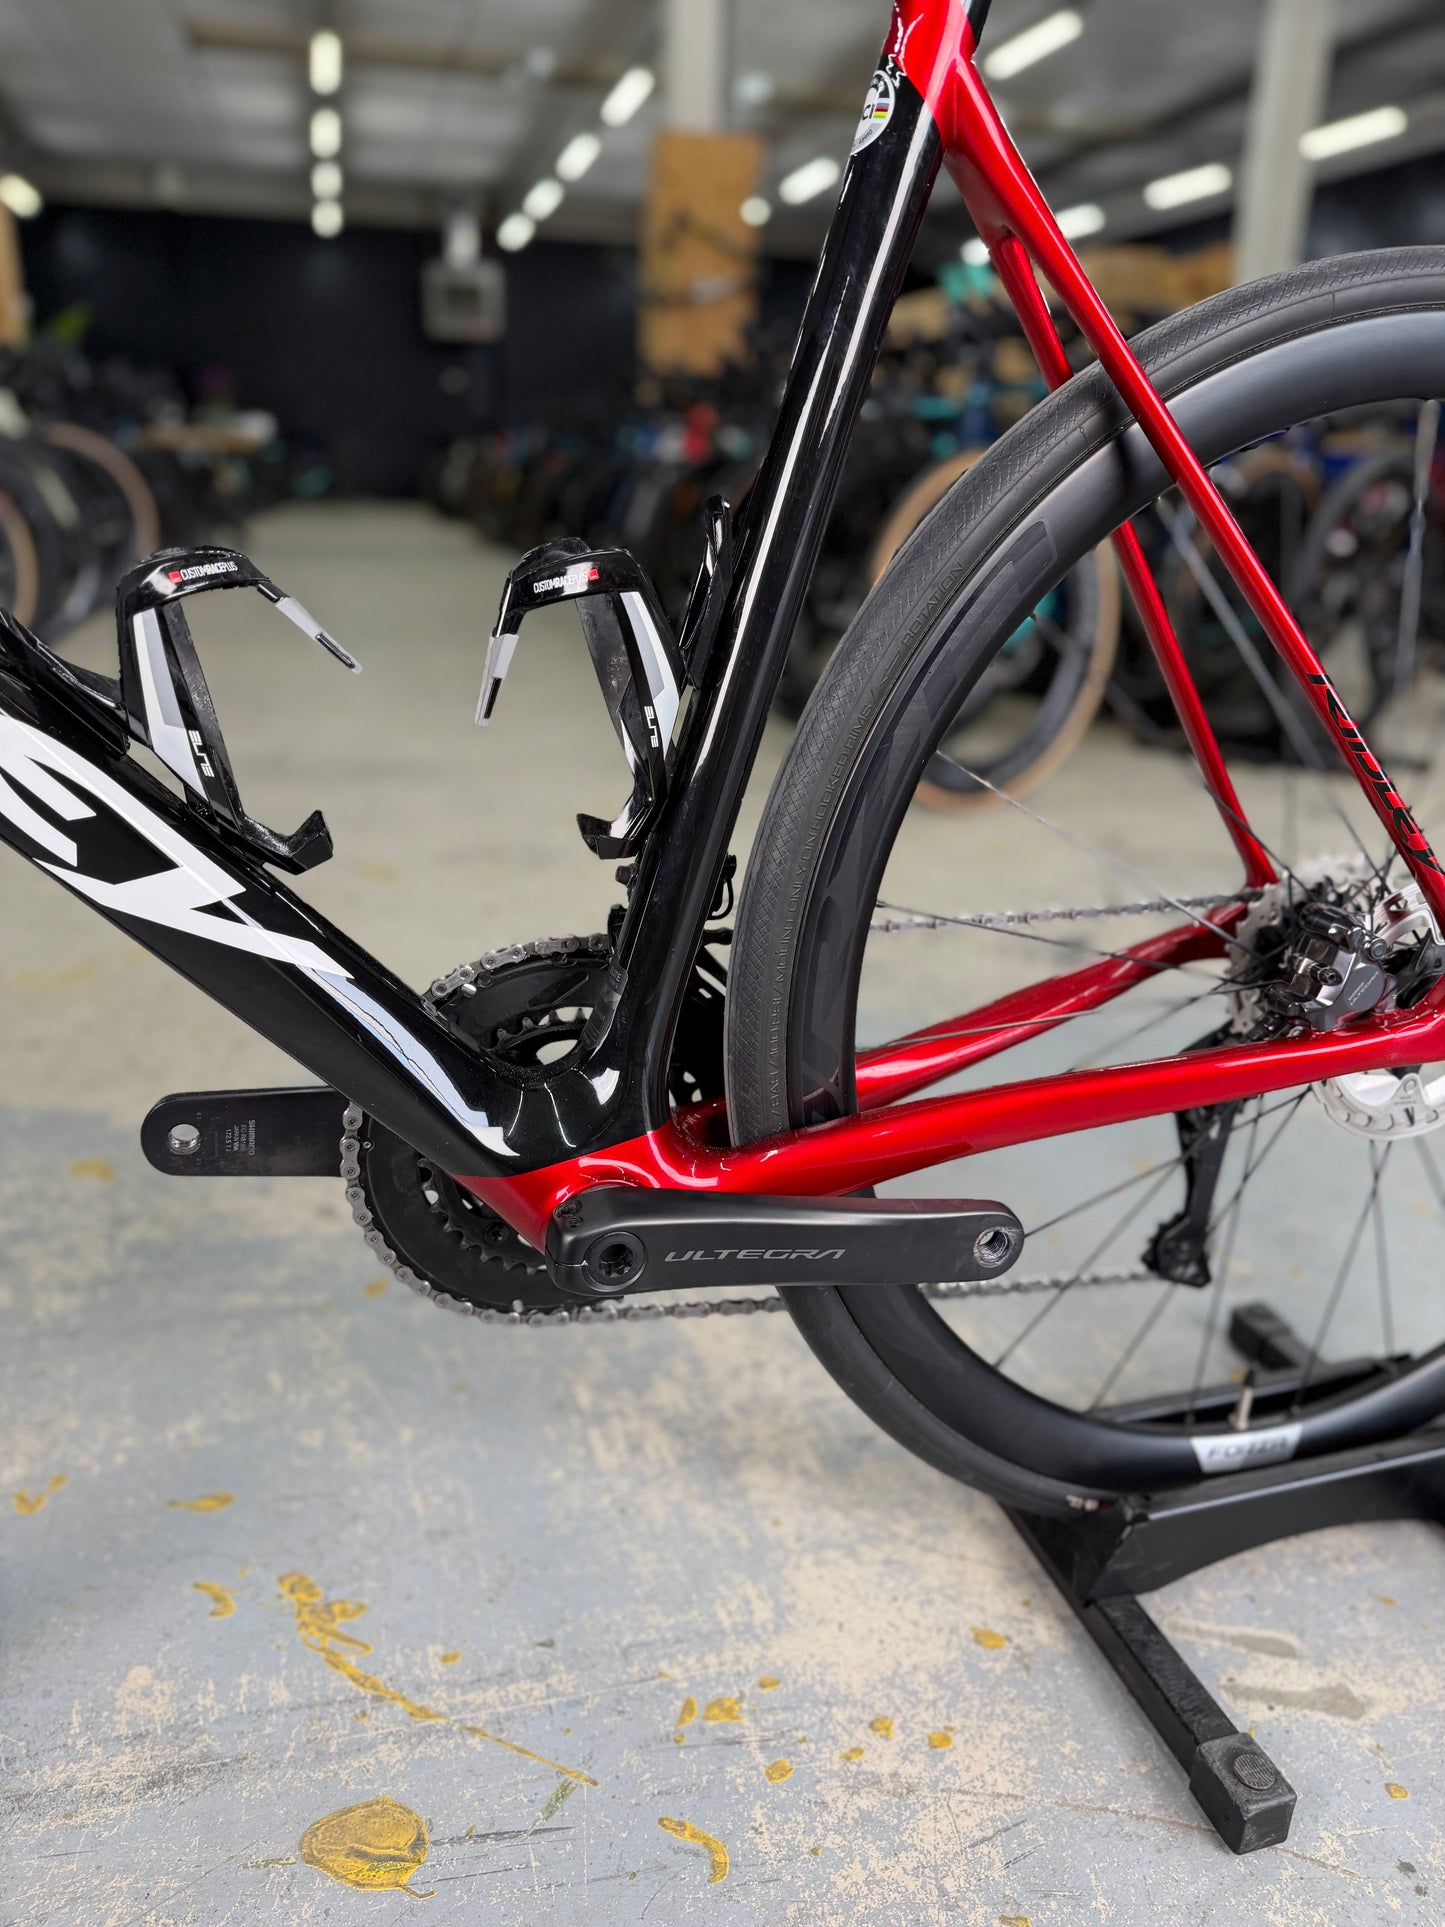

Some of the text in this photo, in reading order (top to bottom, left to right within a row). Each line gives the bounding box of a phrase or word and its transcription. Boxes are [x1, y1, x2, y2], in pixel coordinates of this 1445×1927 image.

[900, 561, 964, 648] ROTATION
[644, 705, 659, 748] ELITE
[188, 730, 215, 778] ELITE
[1306, 673, 1445, 876] RIDLEY
[774, 915, 794, 984] MOUNT
[788, 864, 807, 913] ONLY
[802, 831, 818, 861] ON
[812, 753, 848, 831] HOOKED
[844, 703, 873, 753] RIMS
[248, 1119, 256, 1156] SHIMANO
[664, 1249, 846, 1262] ULTEGRA
